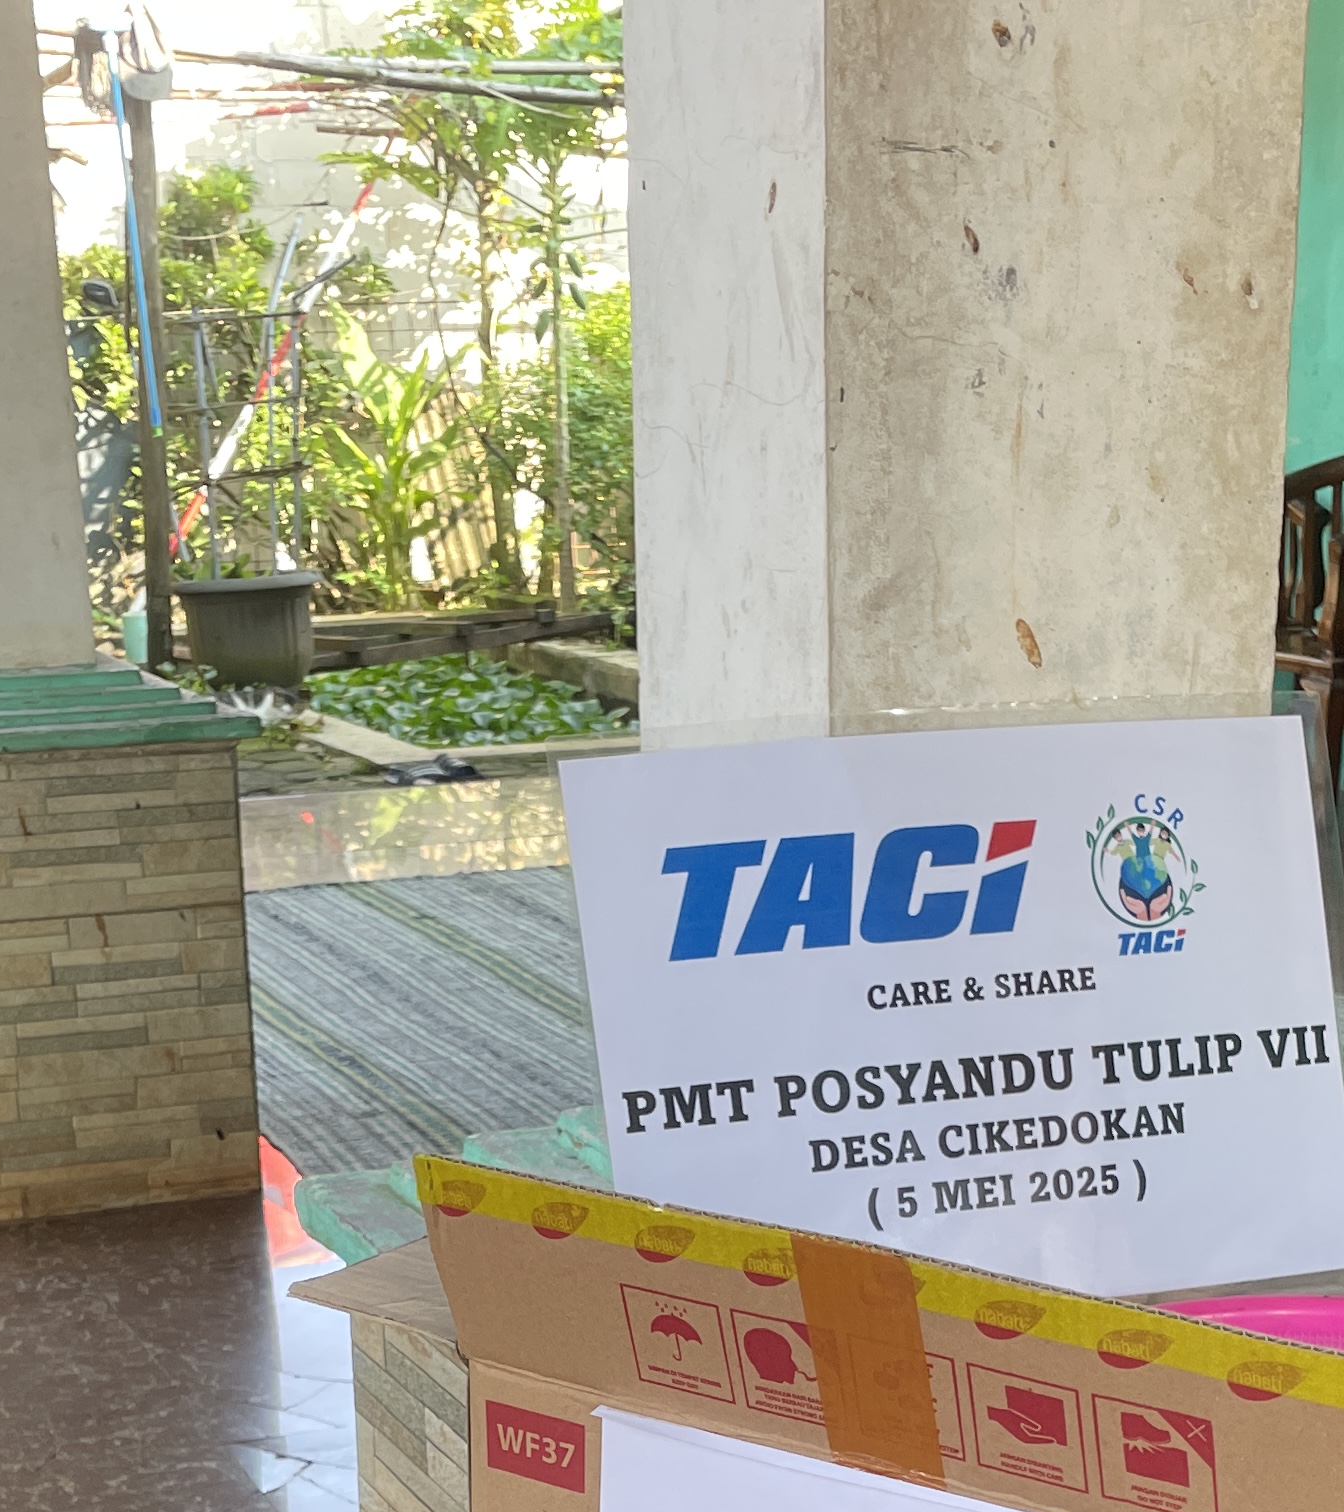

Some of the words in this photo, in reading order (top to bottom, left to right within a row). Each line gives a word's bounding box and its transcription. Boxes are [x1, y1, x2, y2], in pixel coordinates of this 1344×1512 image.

[1134, 793, 1185, 830] CSR
[867, 979, 953, 1010] CARE
[962, 976, 985, 1001] &
[994, 966, 1097, 999] SHARE
[621, 1079, 755, 1134] PMT
[773, 1047, 1074, 1118] POSYANDU
[1090, 1032, 1243, 1085] TULIP
[1255, 1024, 1331, 1068] VII
[808, 1129, 926, 1173] DESA
[938, 1101, 1186, 1158] CIKEDOKAN
[896, 1186, 918, 1218] 5
[931, 1173, 1016, 1214] MEI
[1028, 1163, 1120, 1203] 2025
[496, 1423, 576, 1468] WF37
